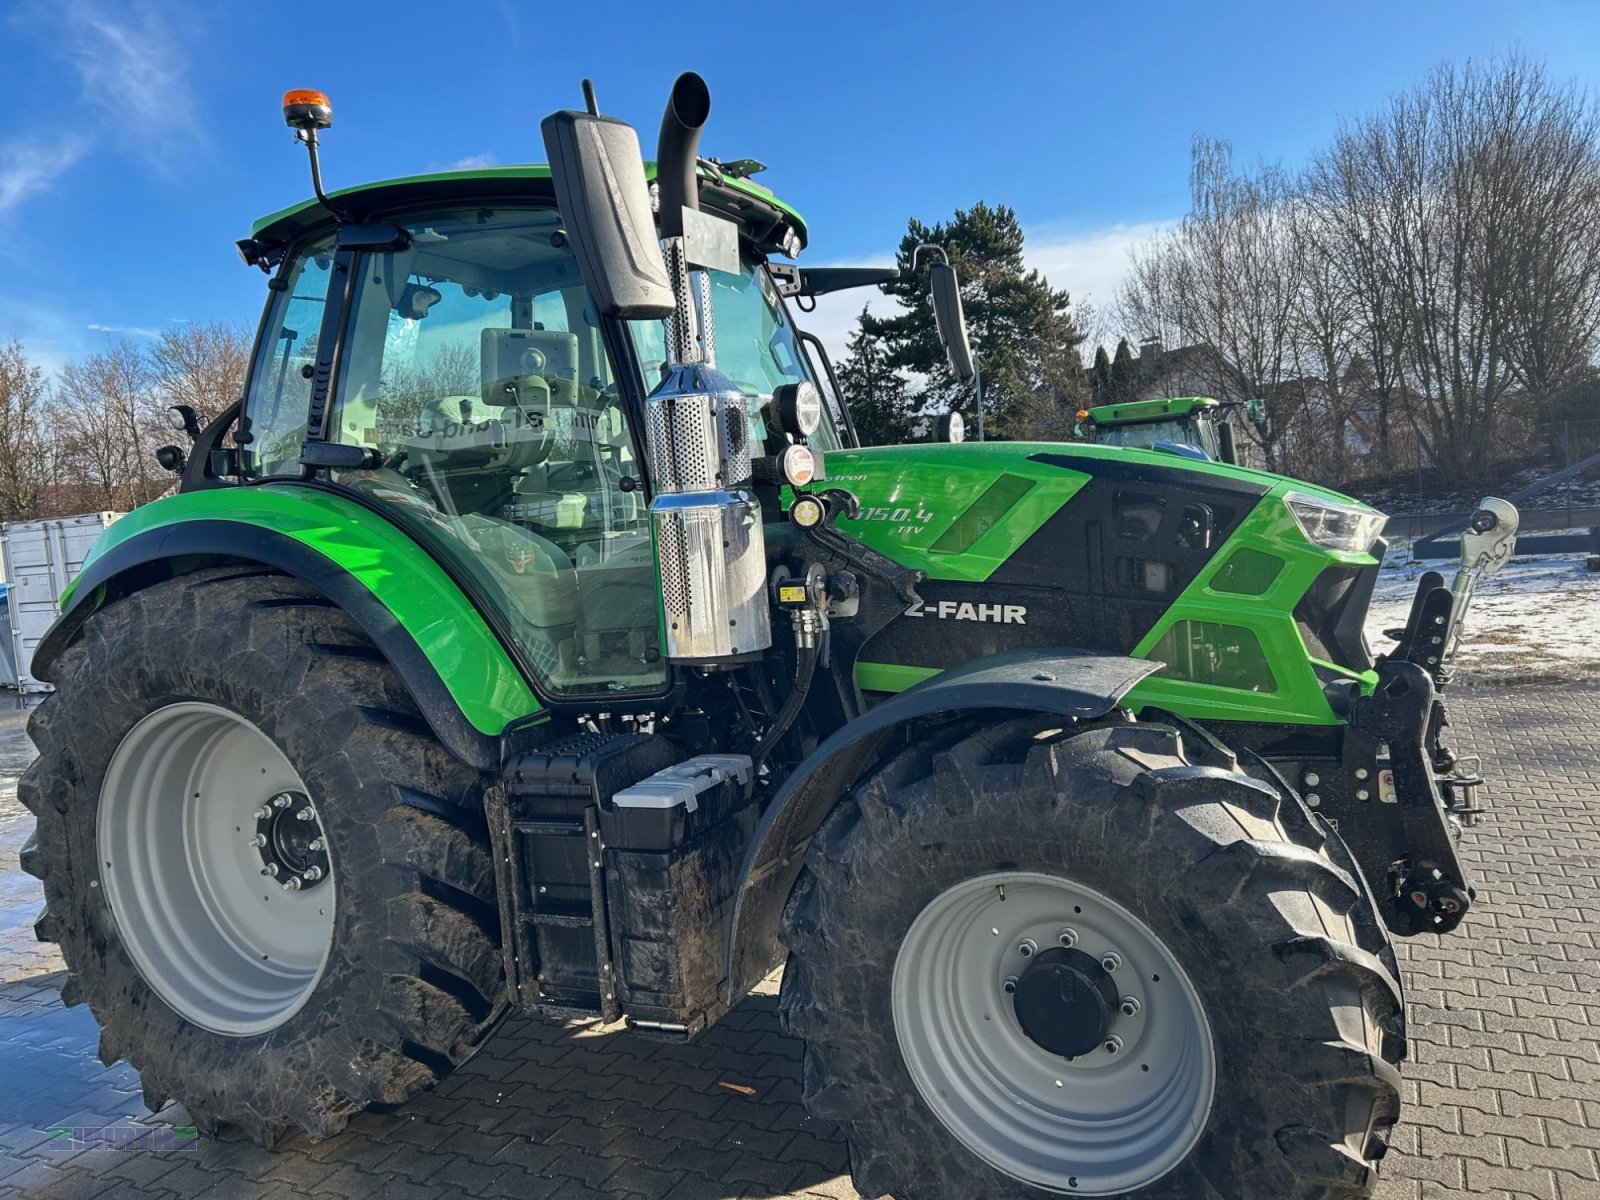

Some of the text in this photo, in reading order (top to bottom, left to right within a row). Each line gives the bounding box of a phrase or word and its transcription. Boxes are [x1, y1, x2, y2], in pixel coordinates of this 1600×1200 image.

[823, 474, 868, 482] otron
[897, 525, 925, 535] TTV
[904, 600, 1027, 625] Z-FAHR
